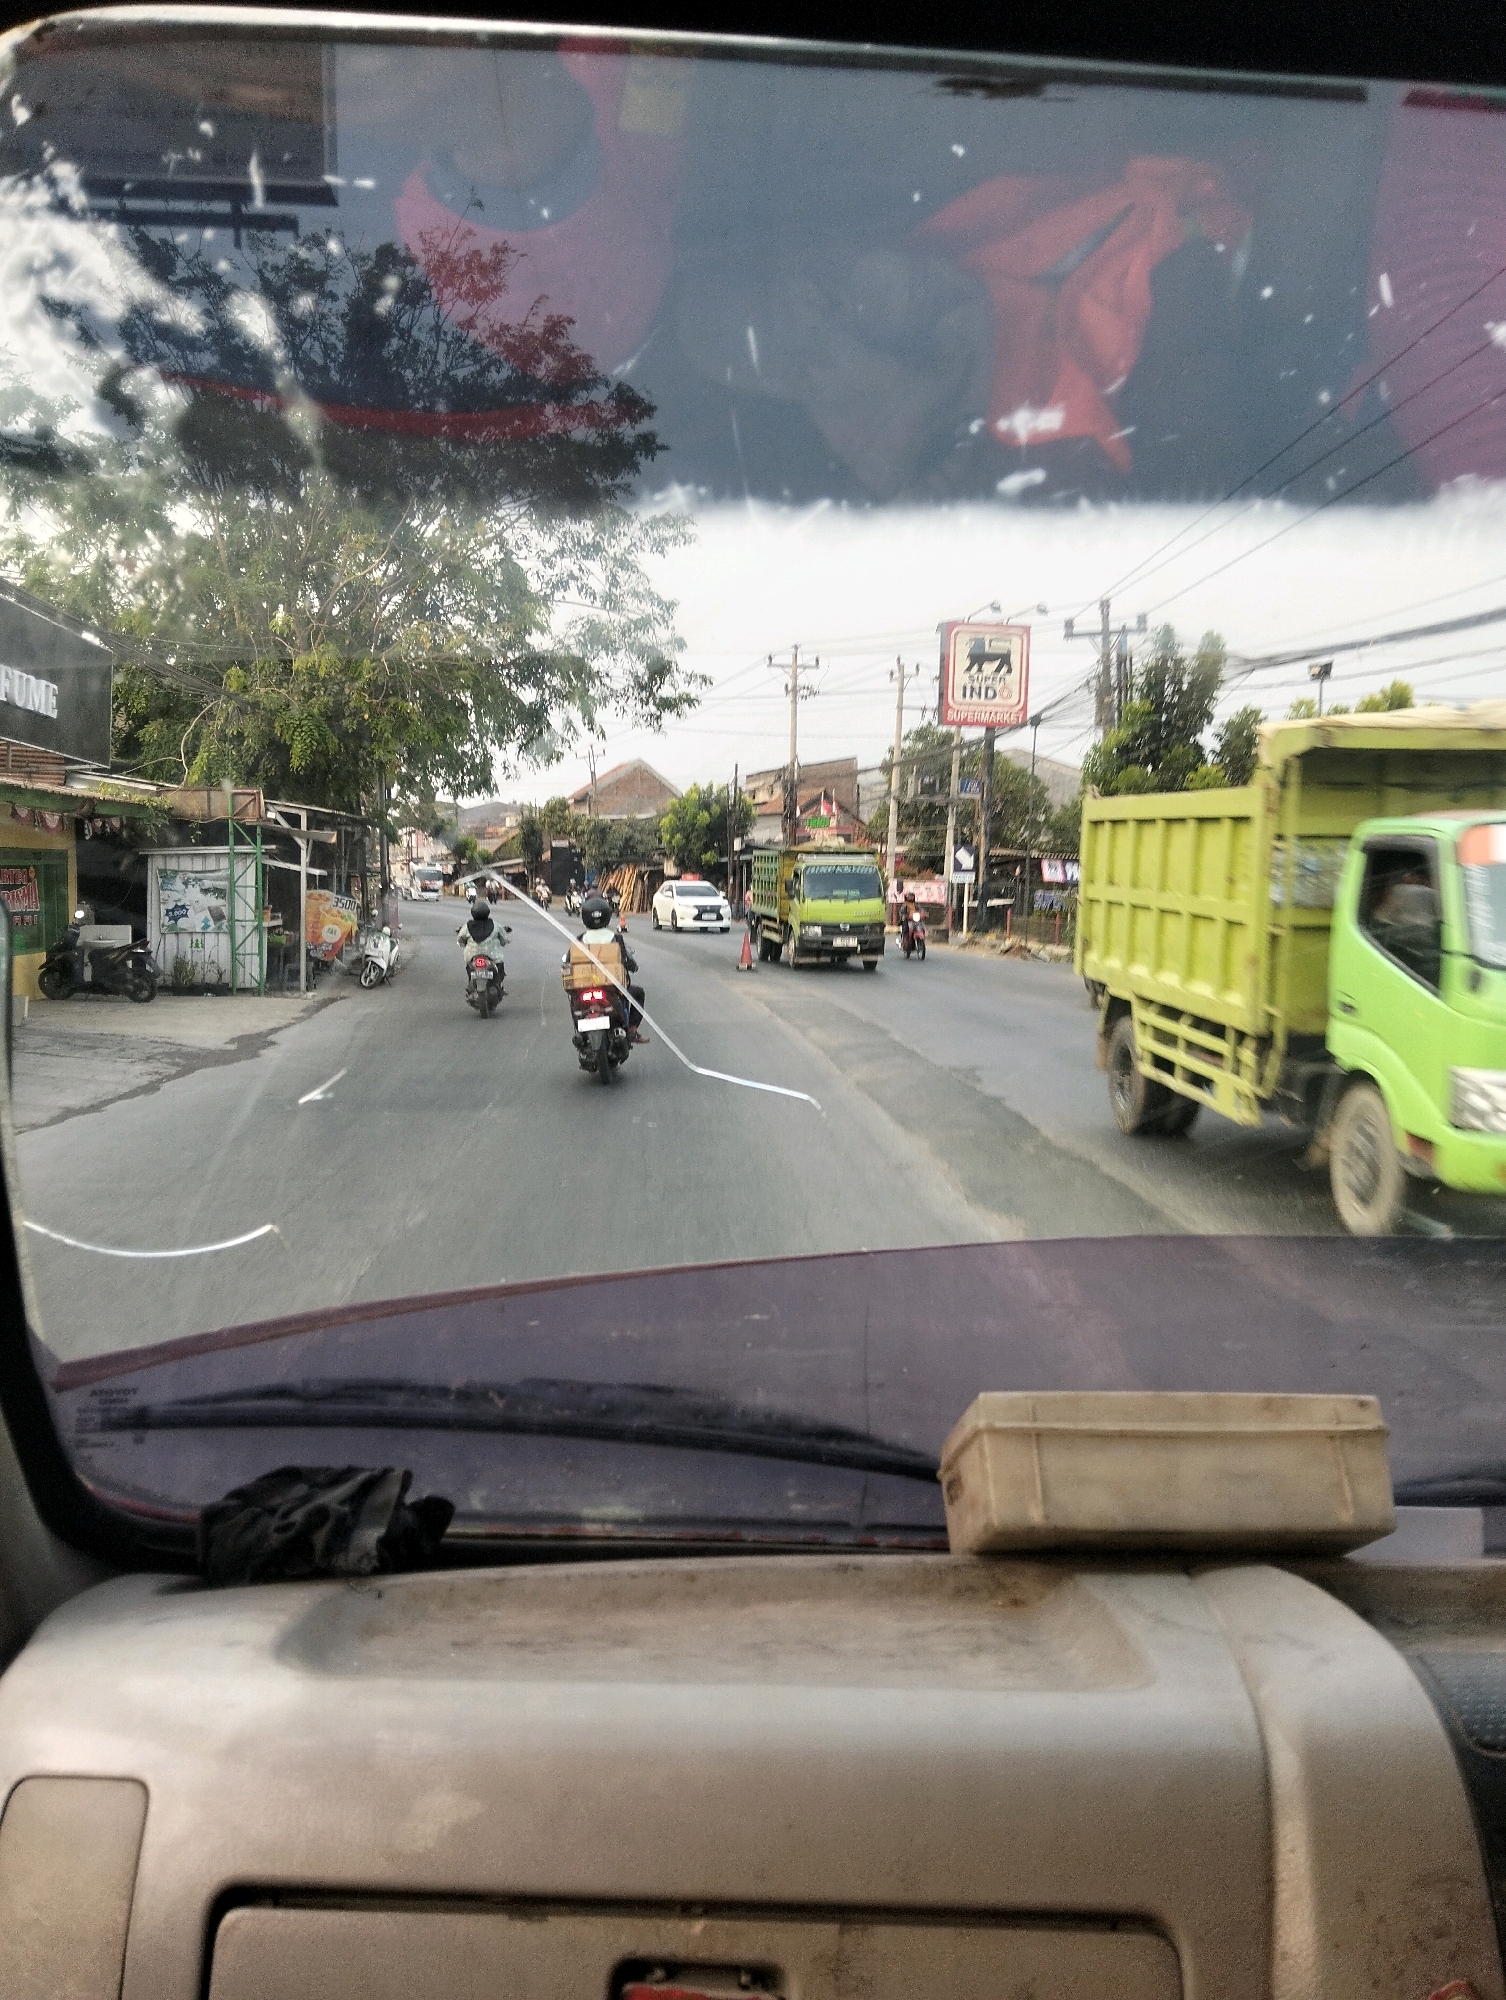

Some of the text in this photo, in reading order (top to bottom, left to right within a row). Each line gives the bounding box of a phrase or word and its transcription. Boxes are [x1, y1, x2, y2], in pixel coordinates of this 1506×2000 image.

[967, 675, 1006, 685] SUPER
[946, 708, 1024, 724] SUPERMARKET
[332, 896, 357, 911] 3500
